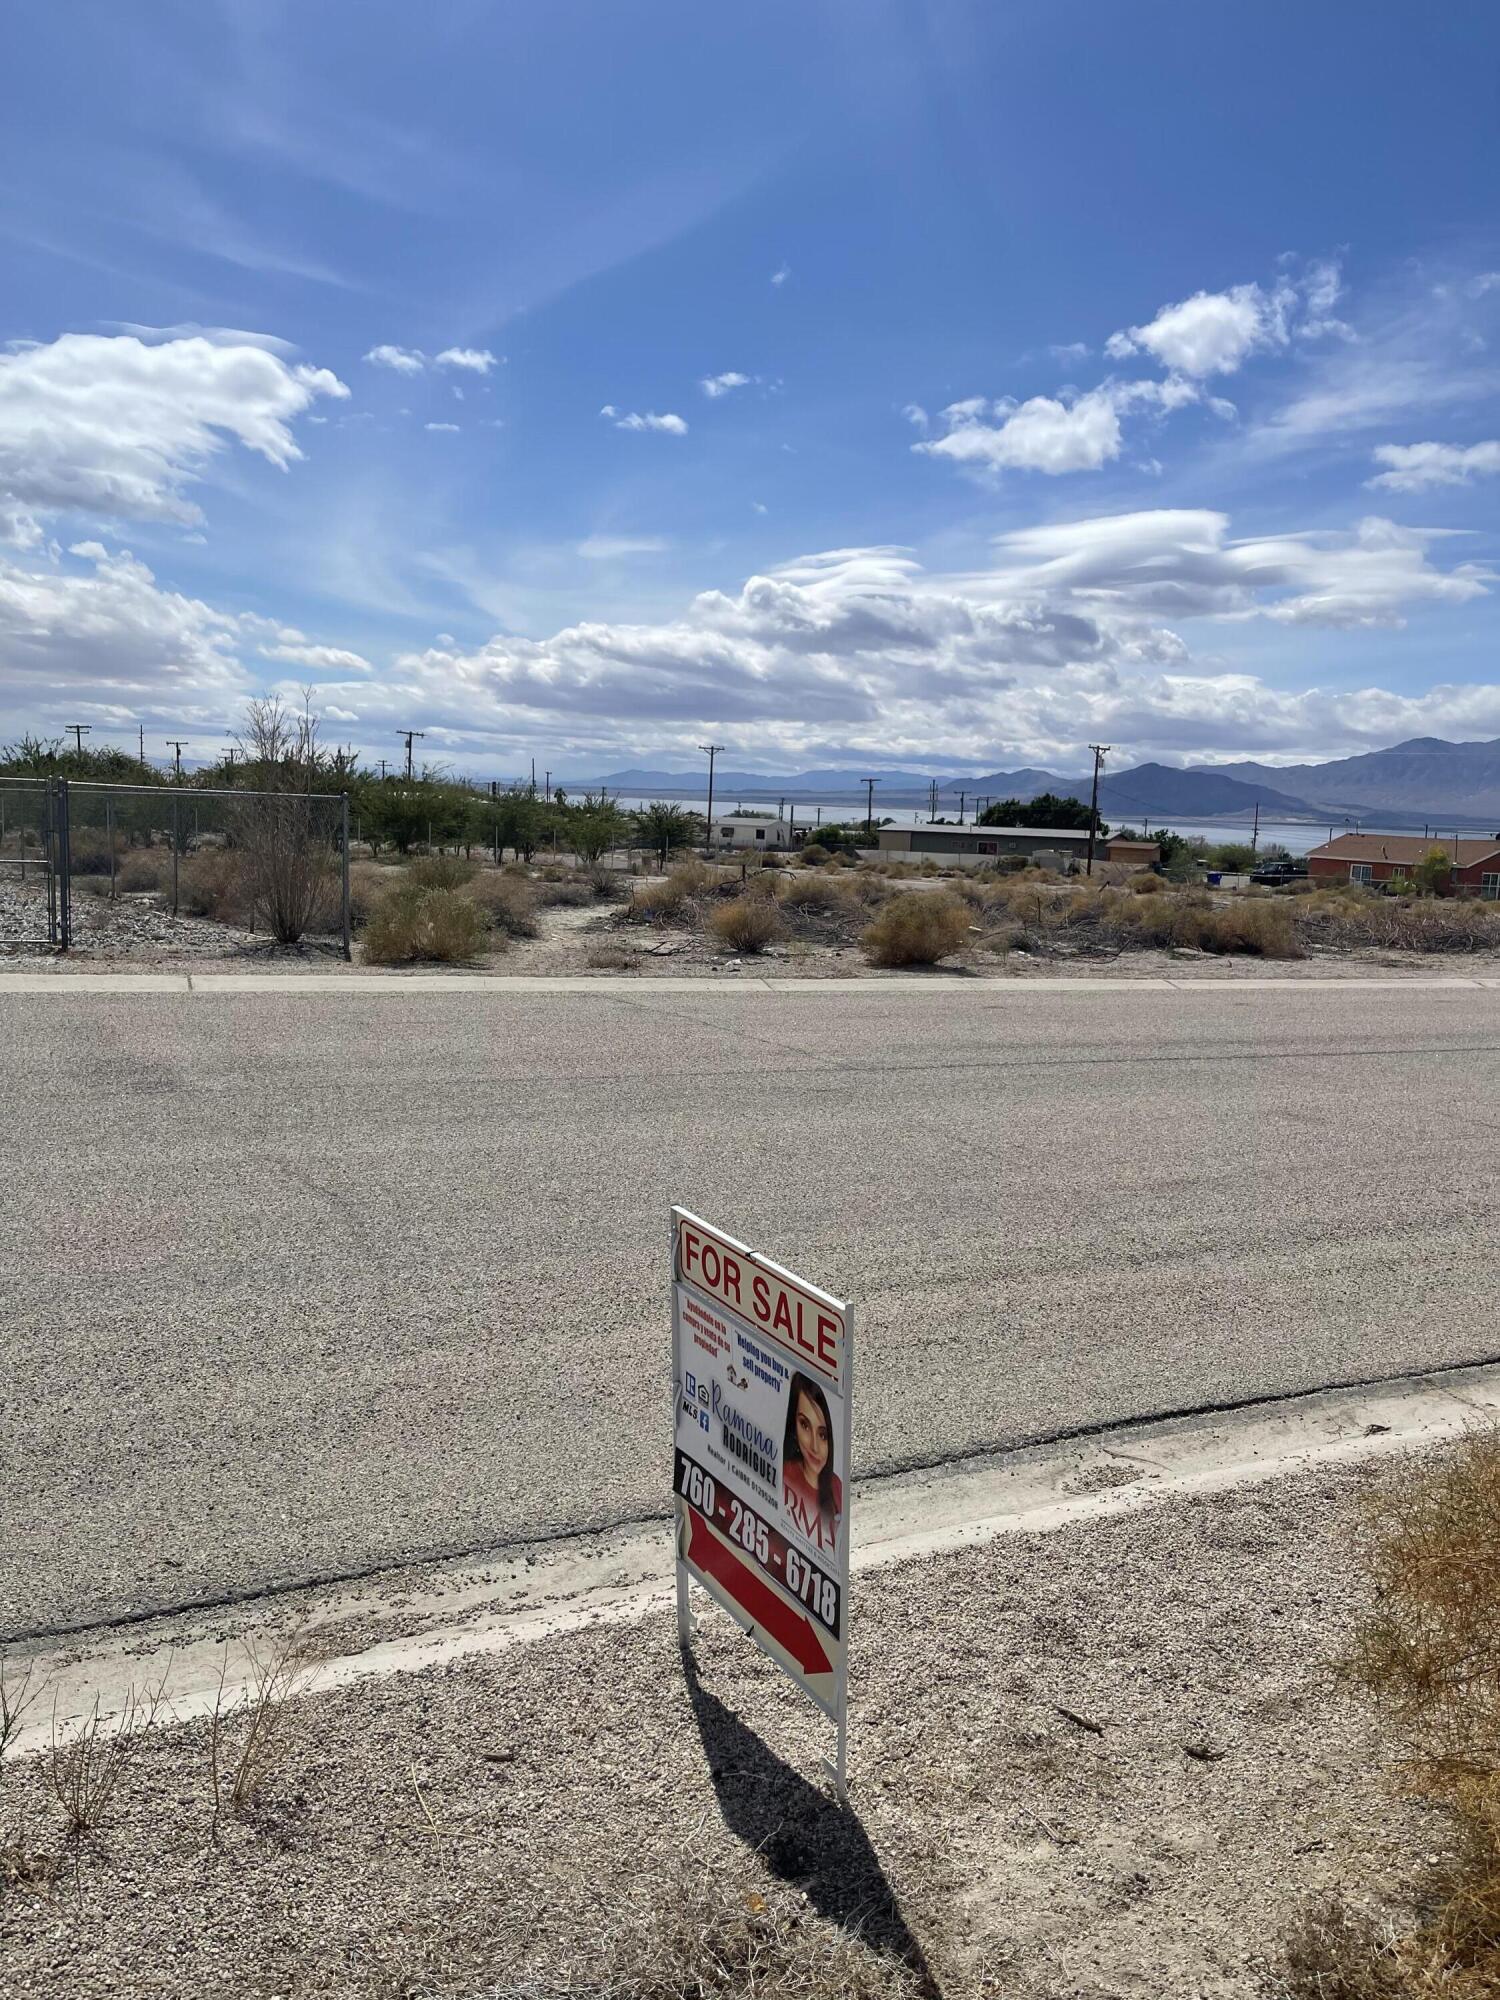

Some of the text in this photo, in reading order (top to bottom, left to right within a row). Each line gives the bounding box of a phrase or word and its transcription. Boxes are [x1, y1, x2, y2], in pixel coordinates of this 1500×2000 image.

[683, 1311, 700, 1330] compra
[704, 1326, 717, 1342] venta
[686, 1231, 837, 1369] FOR SALE
[743, 1356, 753, 1372] sell
[760, 1351, 771, 1368] you
[772, 1357, 783, 1377] buy
[785, 1367, 789, 1379] &
[712, 1379, 778, 1460] Ramona
[680, 1457, 715, 1517] 760
[729, 1502, 769, 1564] 285
[786, 1548, 835, 1626] 6718
